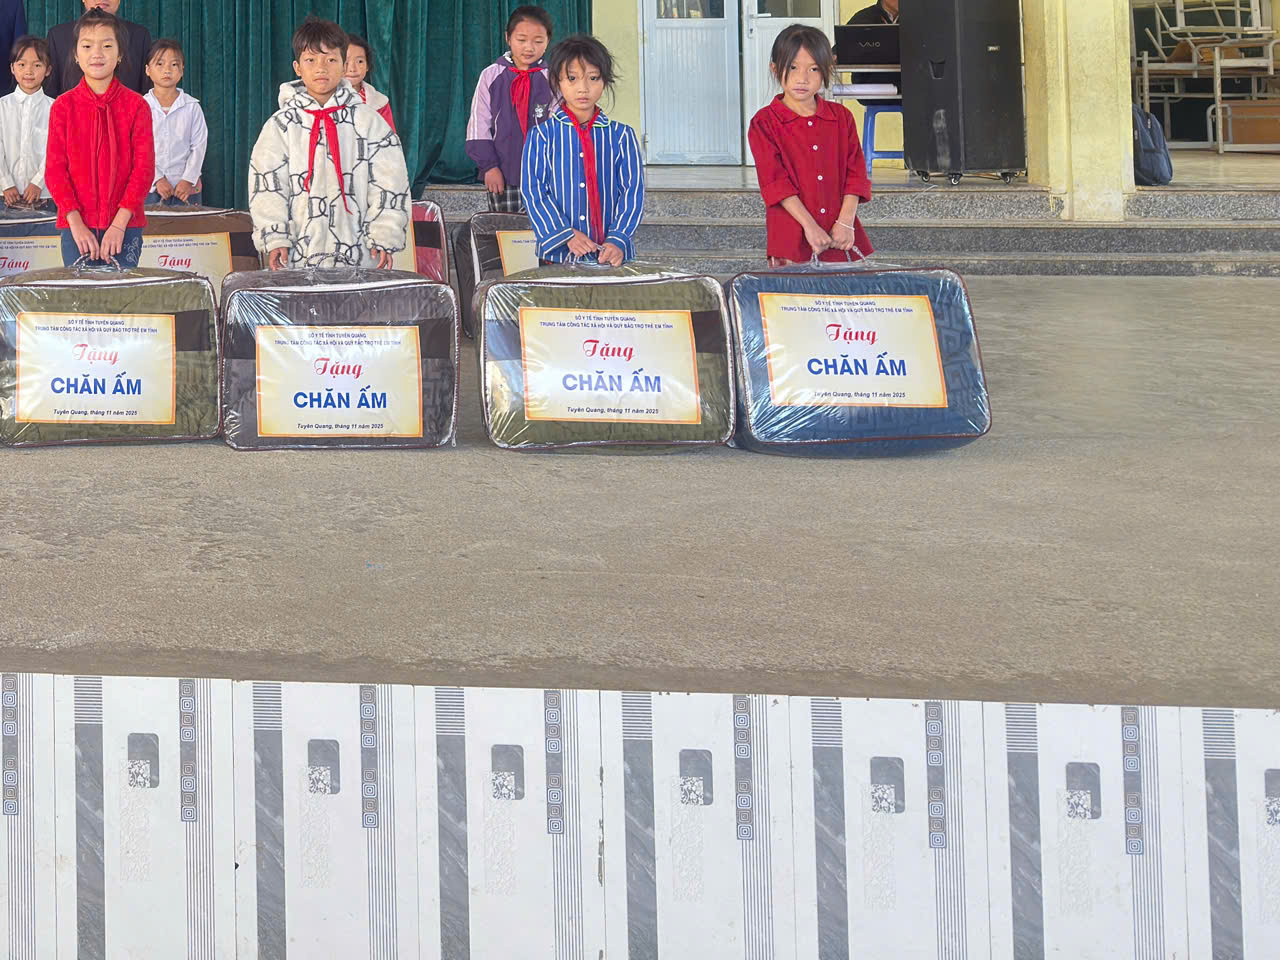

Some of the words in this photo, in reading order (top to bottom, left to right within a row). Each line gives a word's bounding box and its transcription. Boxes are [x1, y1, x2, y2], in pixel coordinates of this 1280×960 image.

[158, 255, 192, 268] Tặng
[826, 324, 876, 345] Tặng
[73, 344, 118, 365] Tặng
[584, 340, 633, 361] Tặng
[314, 358, 362, 379] Tặng
[808, 354, 868, 375] CHĂN
[876, 352, 906, 376] ẤM
[51, 374, 105, 394] CHĂN
[112, 372, 141, 395] ẤM
[562, 370, 622, 392] CHĂN
[630, 368, 661, 392] ẤM
[294, 388, 350, 408] CHĂN
[357, 385, 386, 408] ẤM
